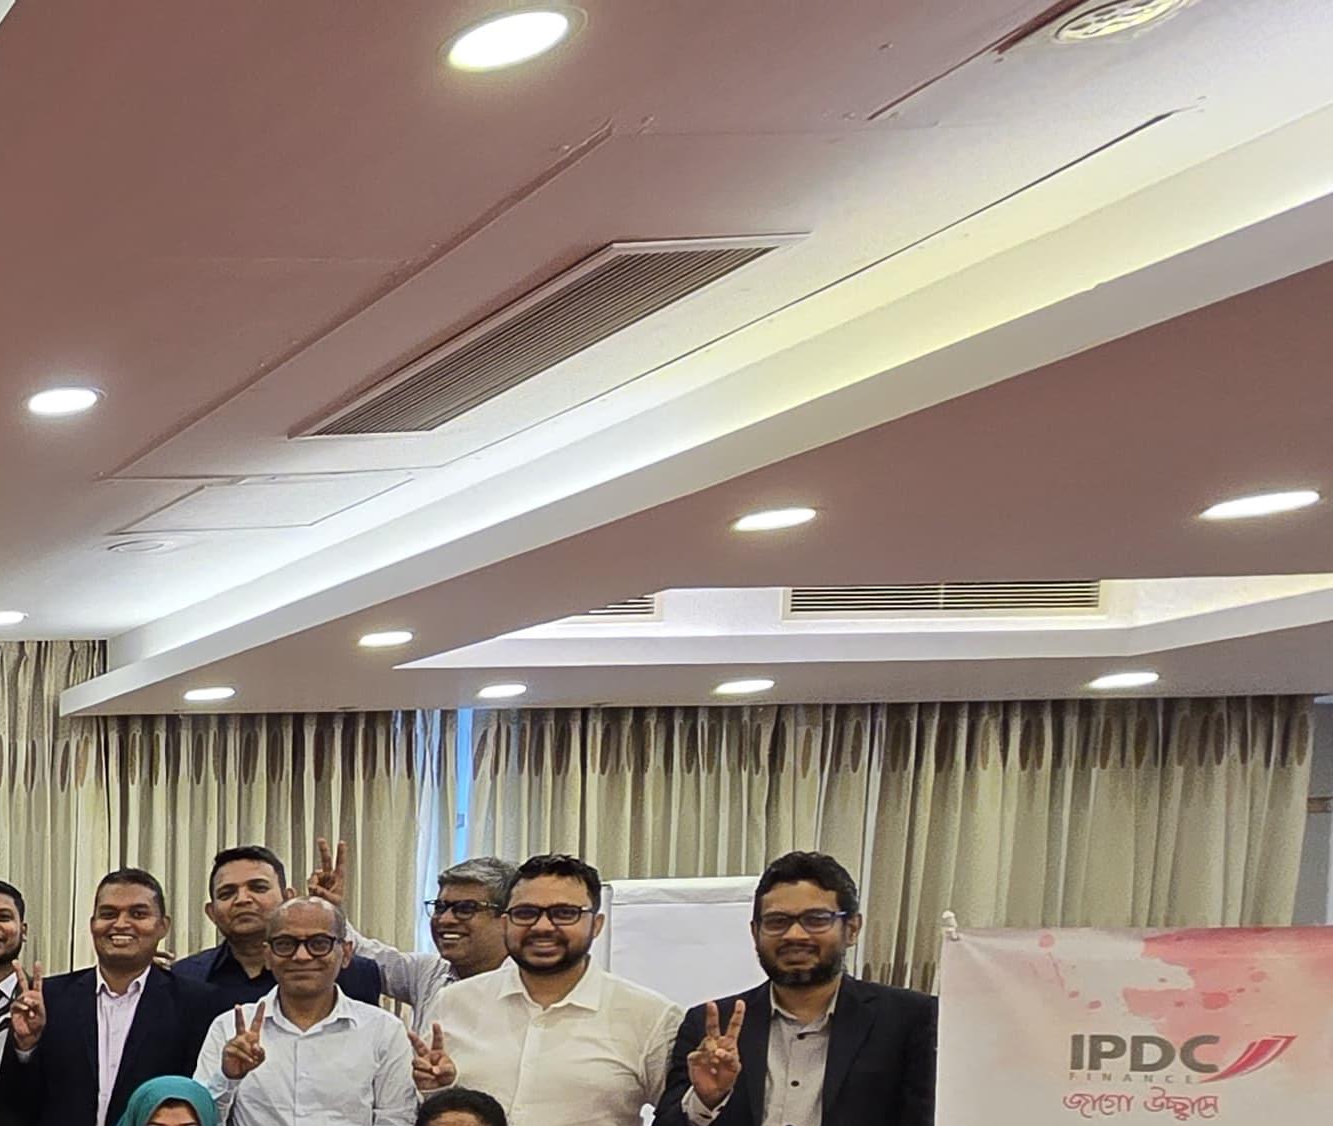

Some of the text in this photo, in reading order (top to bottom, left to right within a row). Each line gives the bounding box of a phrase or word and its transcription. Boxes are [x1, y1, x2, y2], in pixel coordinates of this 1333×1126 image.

[1069, 1034, 1220, 1074] IPDC
[1069, 1072, 1194, 1084] FINANCE
[1062, 1092, 1132, 1119] জাগো
